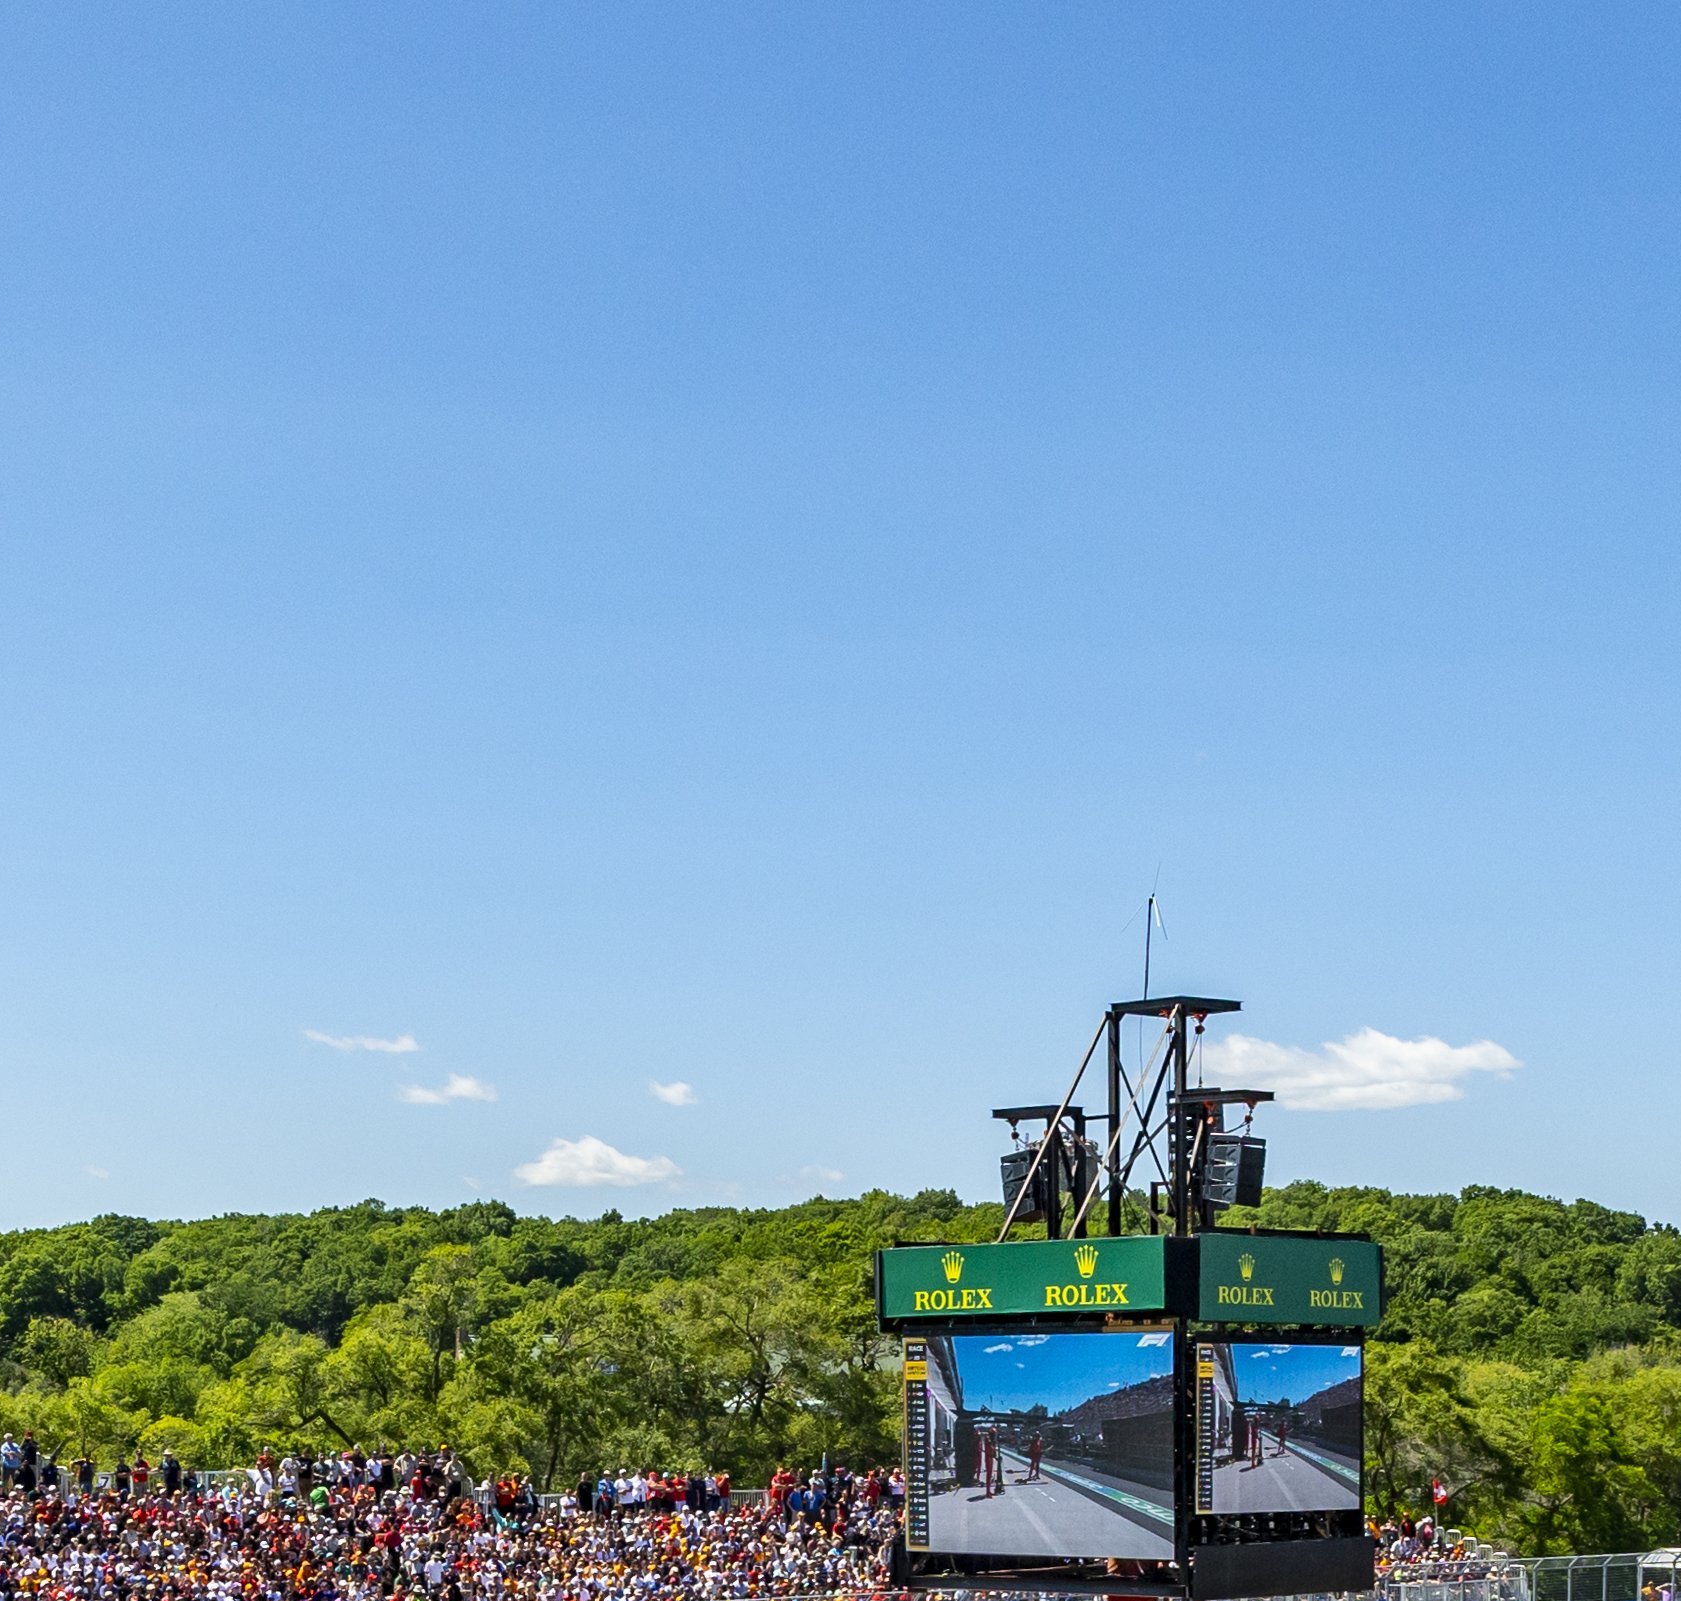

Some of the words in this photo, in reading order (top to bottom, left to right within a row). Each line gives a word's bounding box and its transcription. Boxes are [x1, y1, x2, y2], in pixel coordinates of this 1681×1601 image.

[915, 1289, 992, 1310] ROLEX
[1045, 1284, 1128, 1306] ROLEX
[1219, 1286, 1273, 1305] ROLEX
[1311, 1290, 1362, 1308] ROLEX
